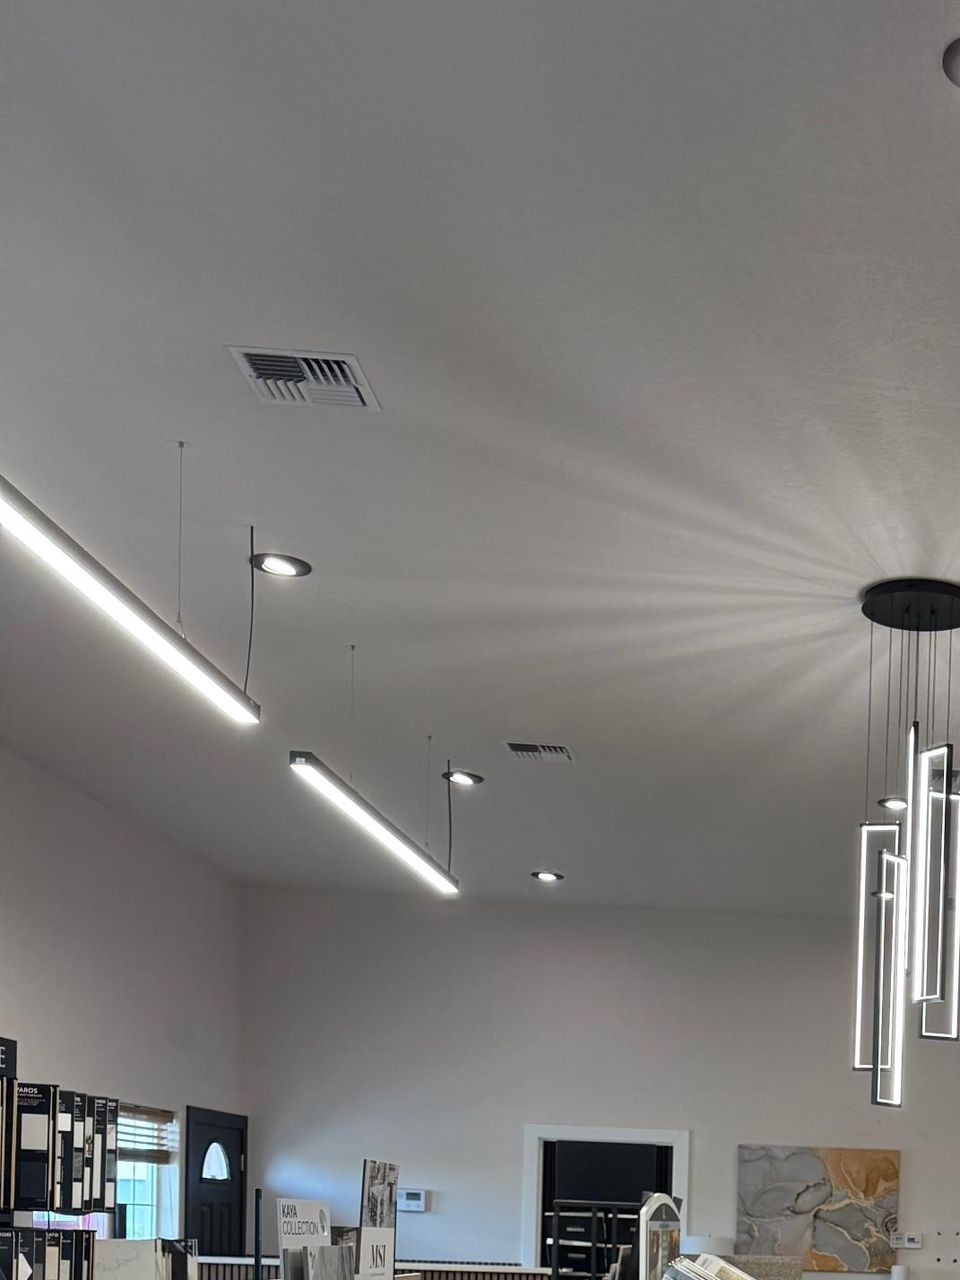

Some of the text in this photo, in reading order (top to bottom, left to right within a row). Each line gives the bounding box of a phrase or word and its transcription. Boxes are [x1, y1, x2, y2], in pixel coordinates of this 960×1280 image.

[282, 1204, 298, 1218] KAYA
[282, 1221, 319, 1235] COLLECTION
[369, 1244, 386, 1269] MSI
